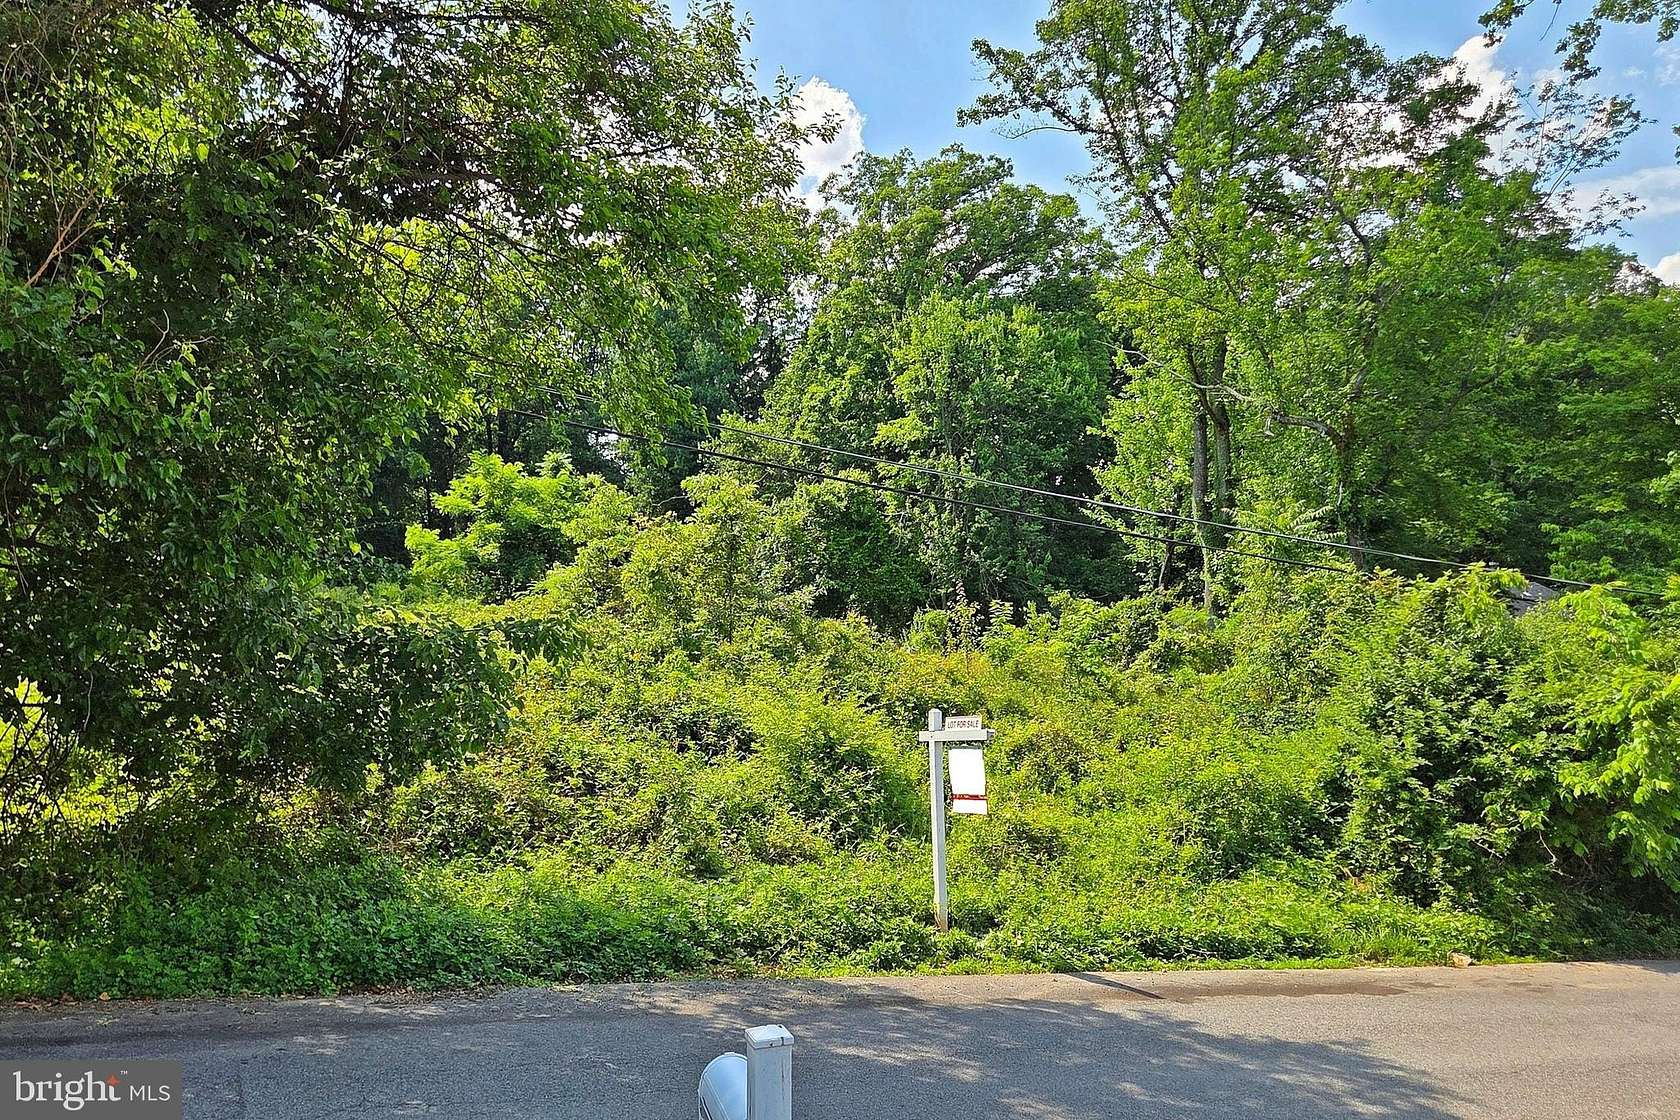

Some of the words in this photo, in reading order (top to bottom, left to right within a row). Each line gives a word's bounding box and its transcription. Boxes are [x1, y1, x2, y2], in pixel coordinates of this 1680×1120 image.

[947, 721, 957, 729] LOT
[957, 720, 966, 728] FOR
[967, 720, 979, 728] SALE
